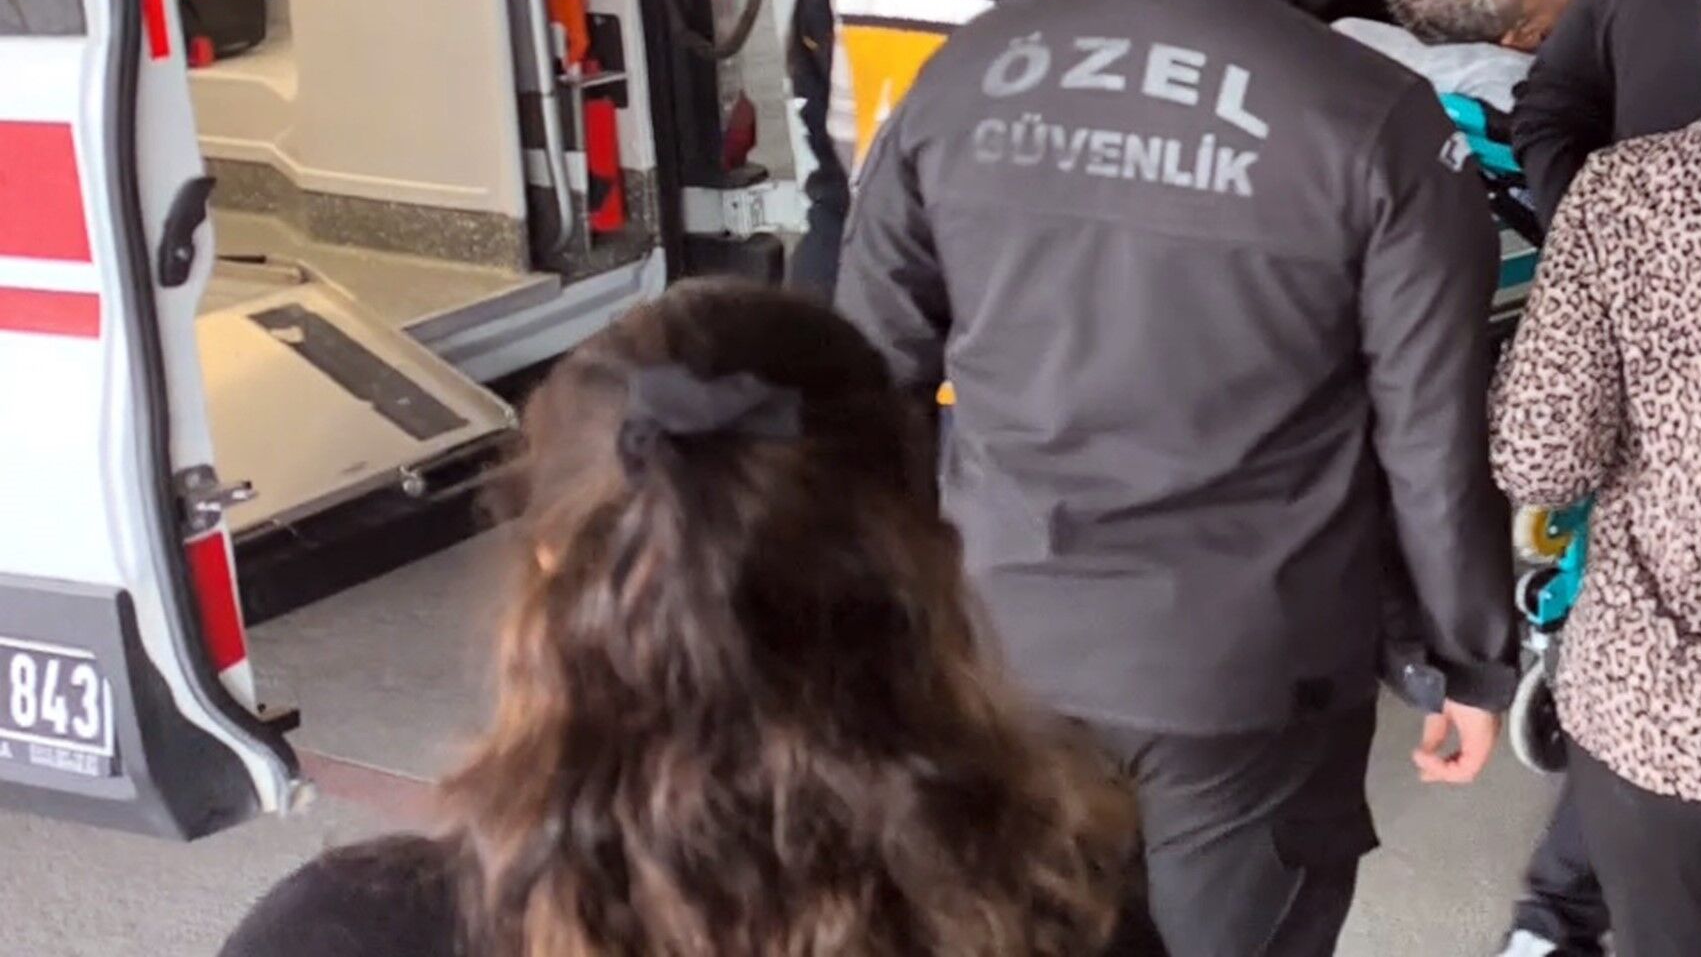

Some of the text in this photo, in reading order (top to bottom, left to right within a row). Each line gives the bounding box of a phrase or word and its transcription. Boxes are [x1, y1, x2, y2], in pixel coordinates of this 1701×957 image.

[981, 31, 1270, 140] ÖZEL
[973, 112, 1260, 198] GÜVENLİK
[9, 652, 100, 740] 843
